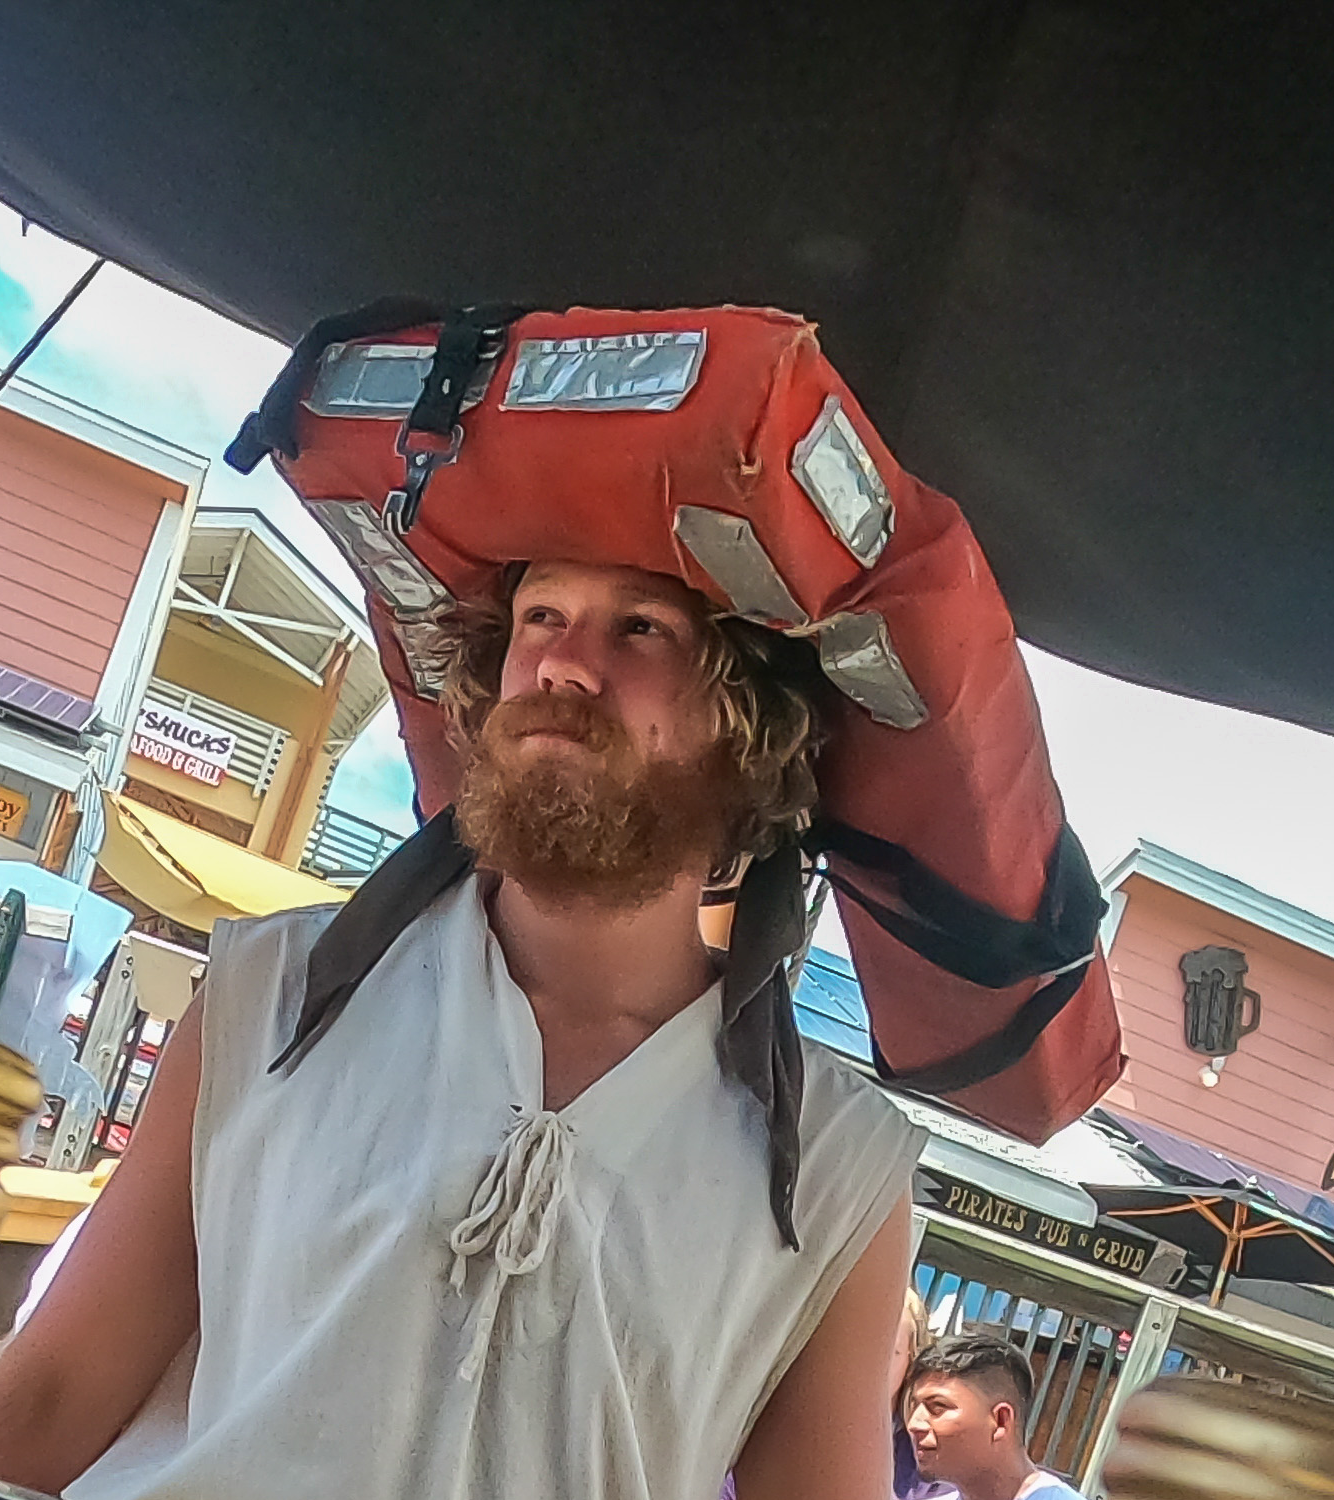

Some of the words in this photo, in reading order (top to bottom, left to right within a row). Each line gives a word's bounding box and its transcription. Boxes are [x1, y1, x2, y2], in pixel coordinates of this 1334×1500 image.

[184, 757, 221, 786] GRILL
[945, 1186, 1028, 1232] PIRATES
[1035, 1216, 1072, 1247] PUB
[1093, 1238, 1147, 1272] GRUB
